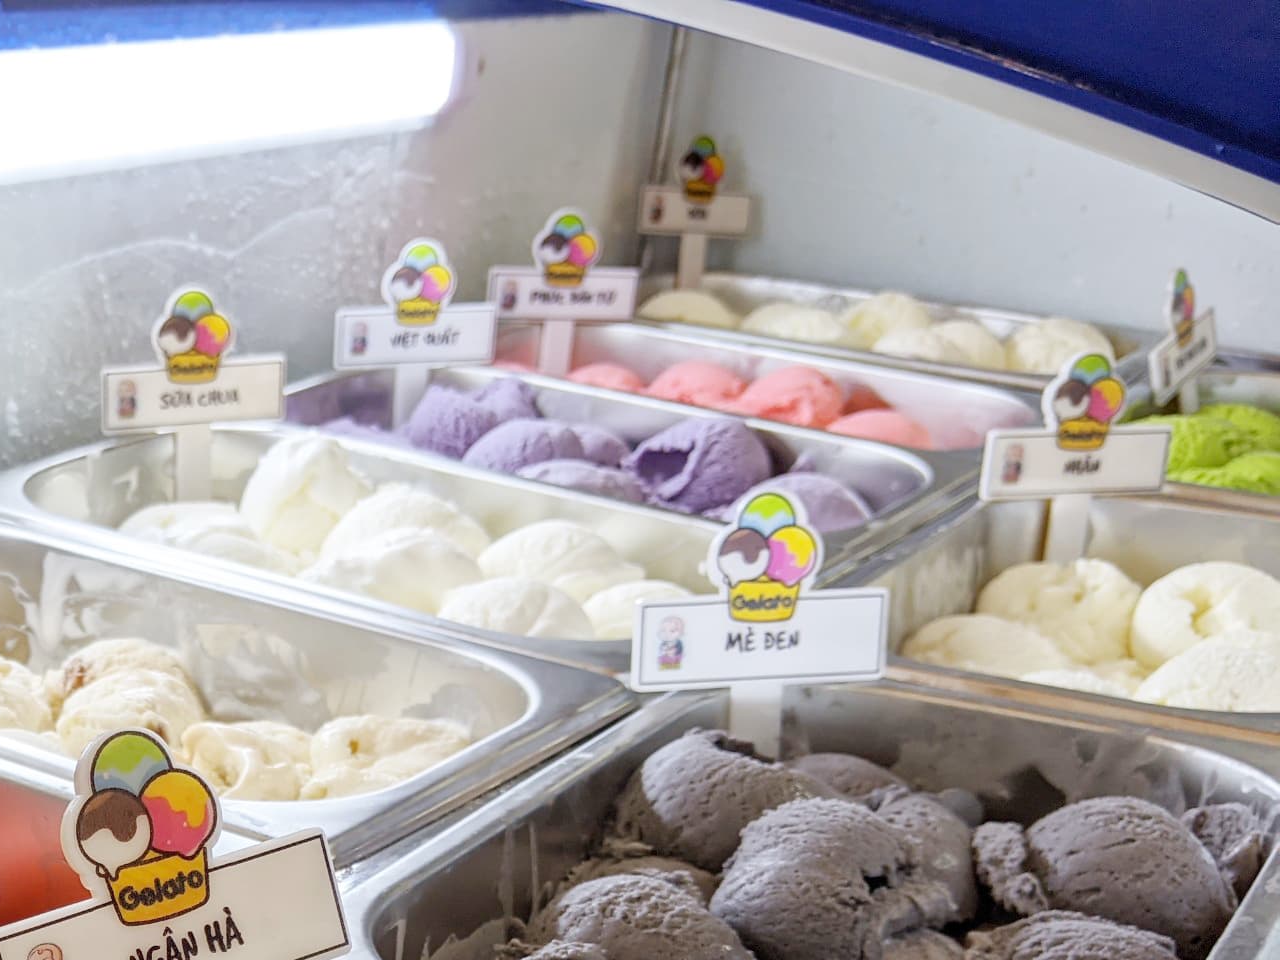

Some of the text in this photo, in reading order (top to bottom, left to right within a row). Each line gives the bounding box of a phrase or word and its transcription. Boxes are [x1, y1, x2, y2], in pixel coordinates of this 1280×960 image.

[732, 594, 793, 611] Gelato
[725, 626, 756, 653] MÈ
[118, 869, 204, 912] Gelato
[204, 906, 245, 954] HÀ
